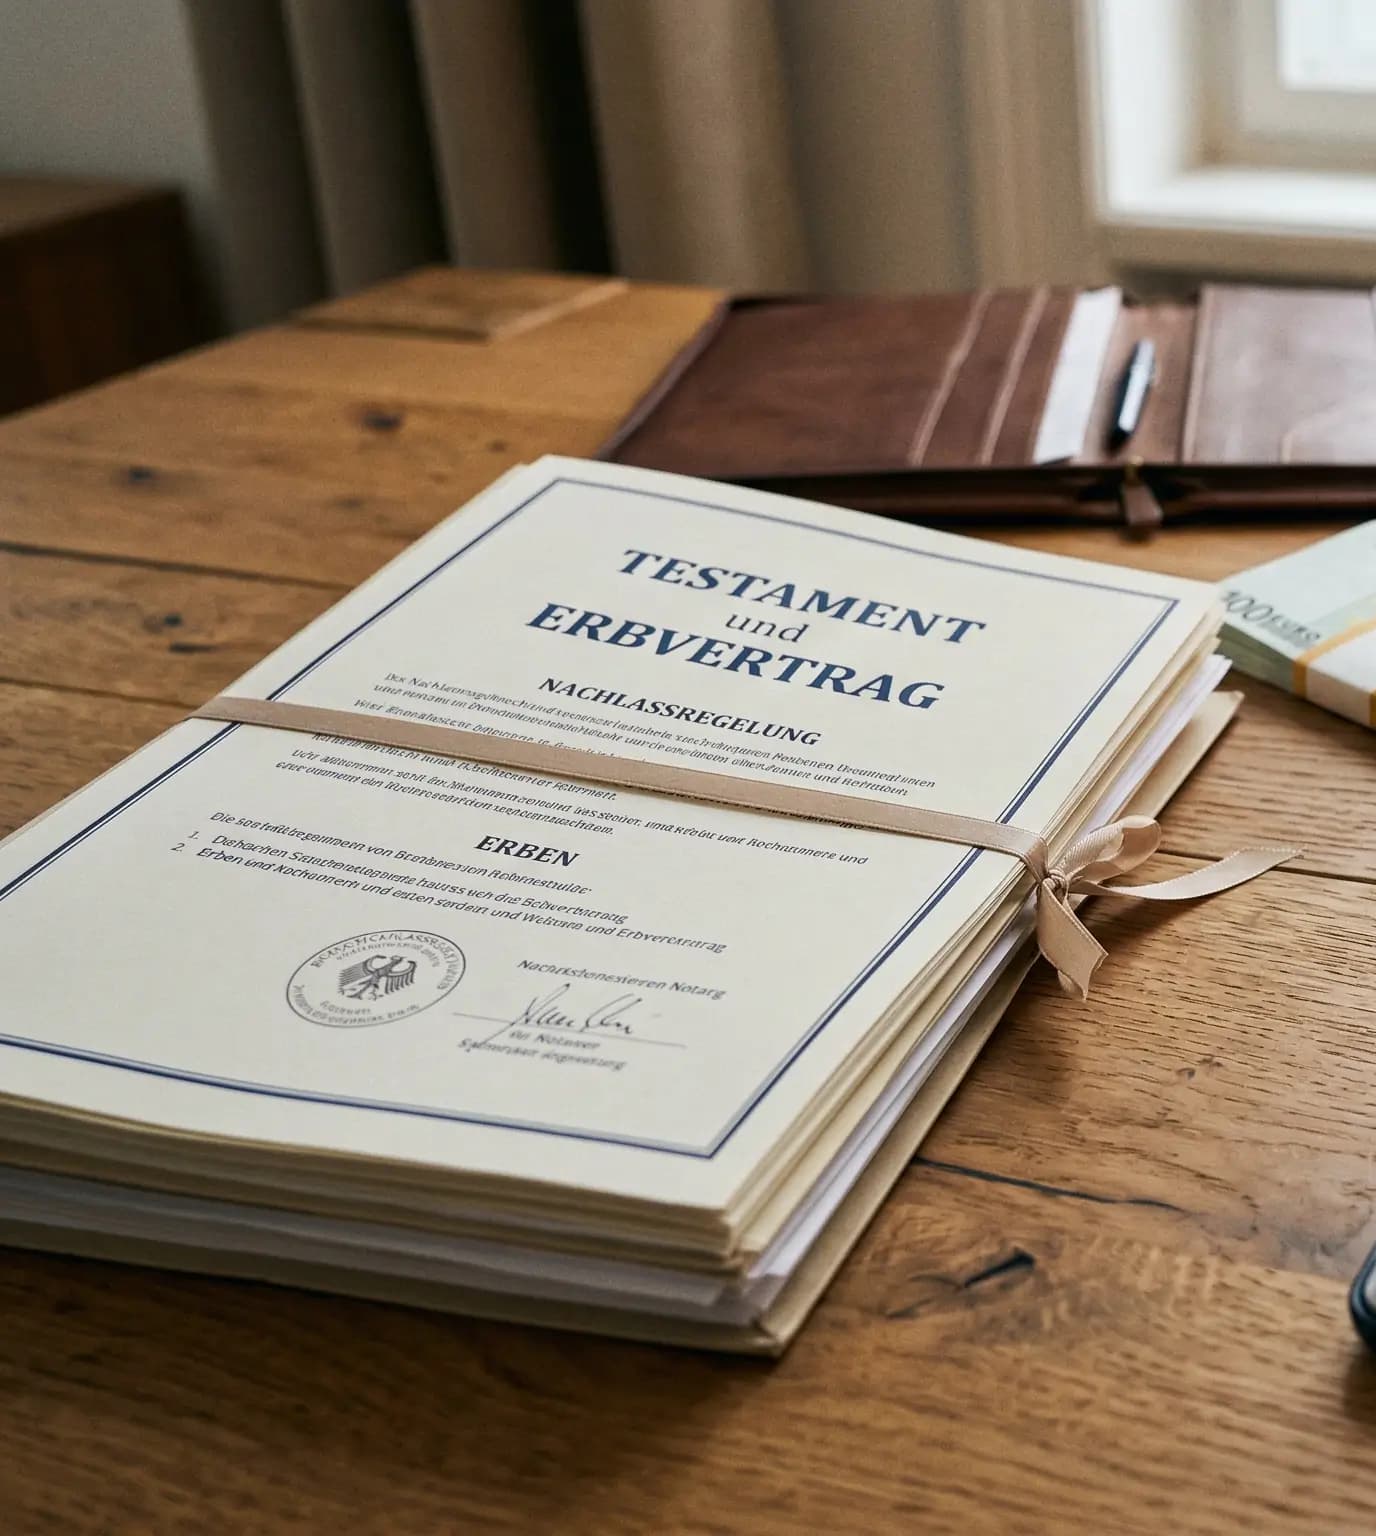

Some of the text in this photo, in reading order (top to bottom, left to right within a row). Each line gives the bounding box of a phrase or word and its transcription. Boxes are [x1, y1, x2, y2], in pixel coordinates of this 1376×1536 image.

[618, 549, 986, 643] TESTAMENT
[725, 613, 809, 643] und
[525, 602, 945, 710] ERBVERTRAG
[538, 678, 822, 746] NACHLASSREGELUNG
[474, 835, 581, 867] ERBEN
[196, 847, 244, 865] Erben
[490, 908, 523, 921] und
[585, 924, 617, 936] und
